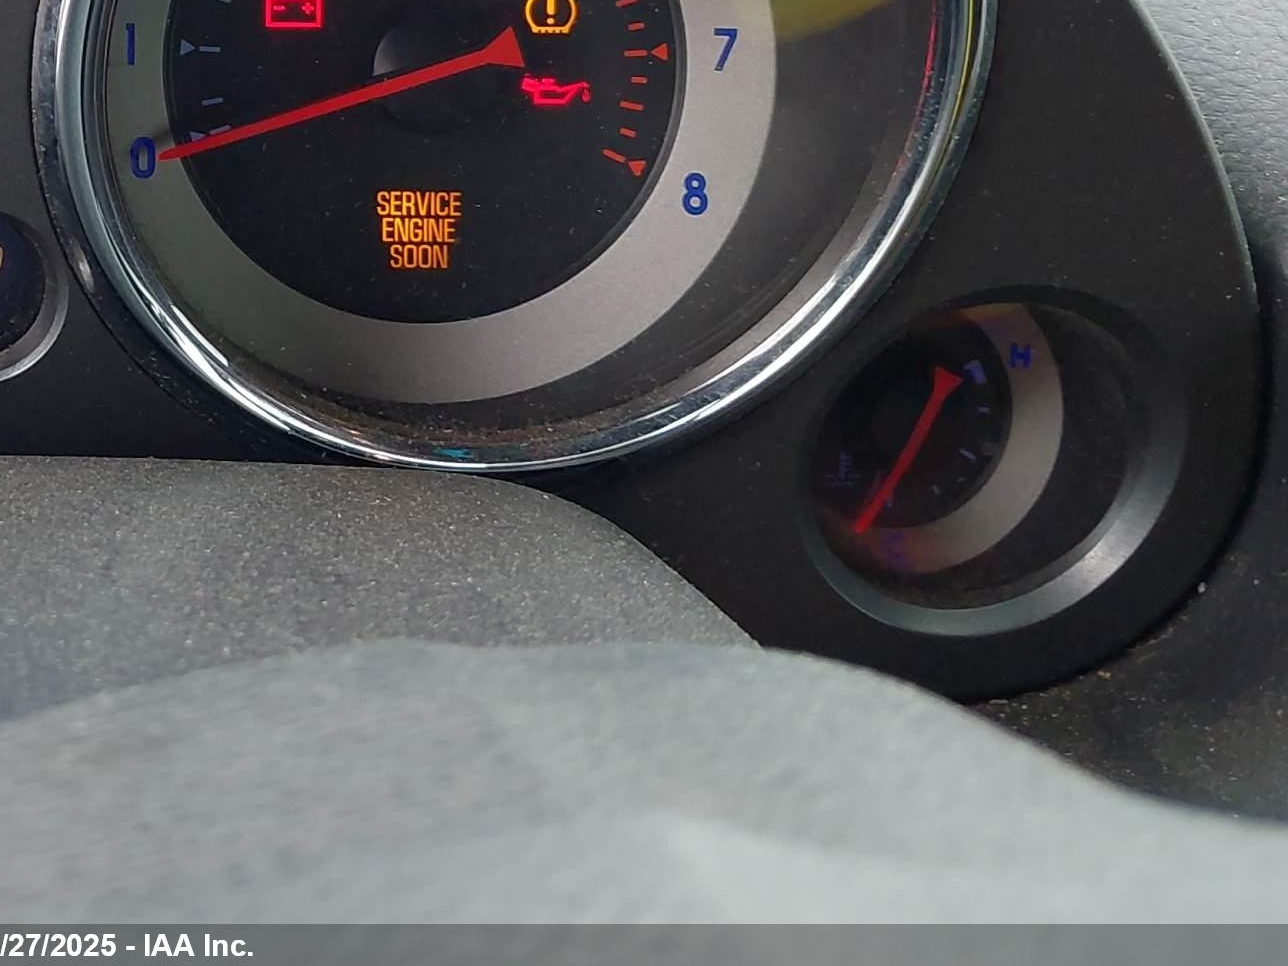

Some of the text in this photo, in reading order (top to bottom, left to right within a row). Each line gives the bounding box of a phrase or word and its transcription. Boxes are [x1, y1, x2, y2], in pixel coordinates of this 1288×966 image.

[125, 24, 136, 65] 1
[712, 28, 739, 71] 7
[129, 136, 156, 178] 0
[376, 191, 462, 216] SERVICE
[681, 172, 709, 215] 8
[382, 217, 456, 242] ENGINE
[390, 244, 448, 268] SOON
[1009, 343, 1033, 369] H
